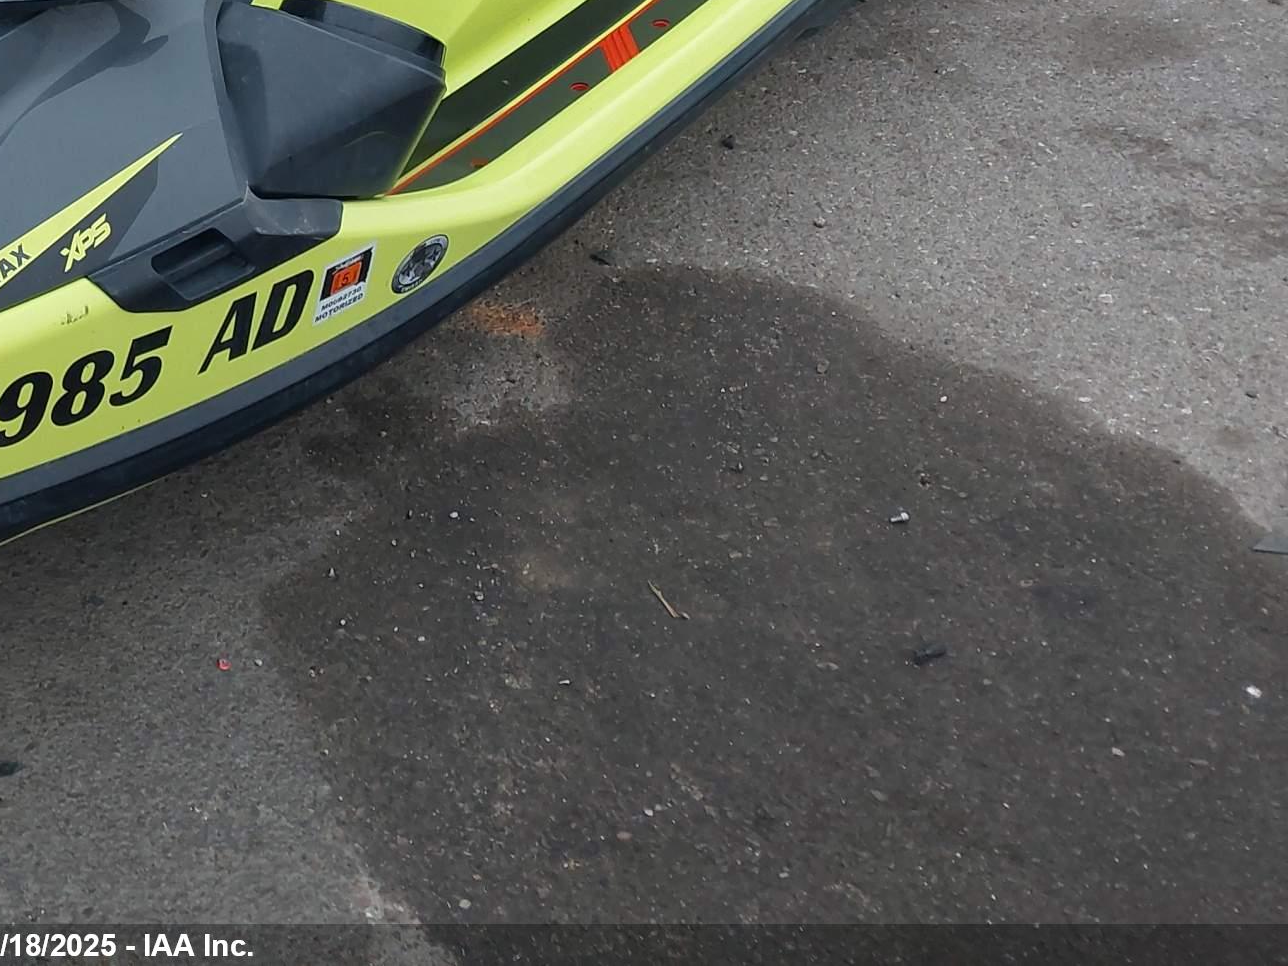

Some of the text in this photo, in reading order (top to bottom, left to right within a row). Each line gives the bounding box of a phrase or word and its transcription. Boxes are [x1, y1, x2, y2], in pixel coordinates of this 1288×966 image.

[60, 213, 112, 274] XPS
[199, 269, 315, 373] AD
[314, 292, 364, 323] MOTORIZED
